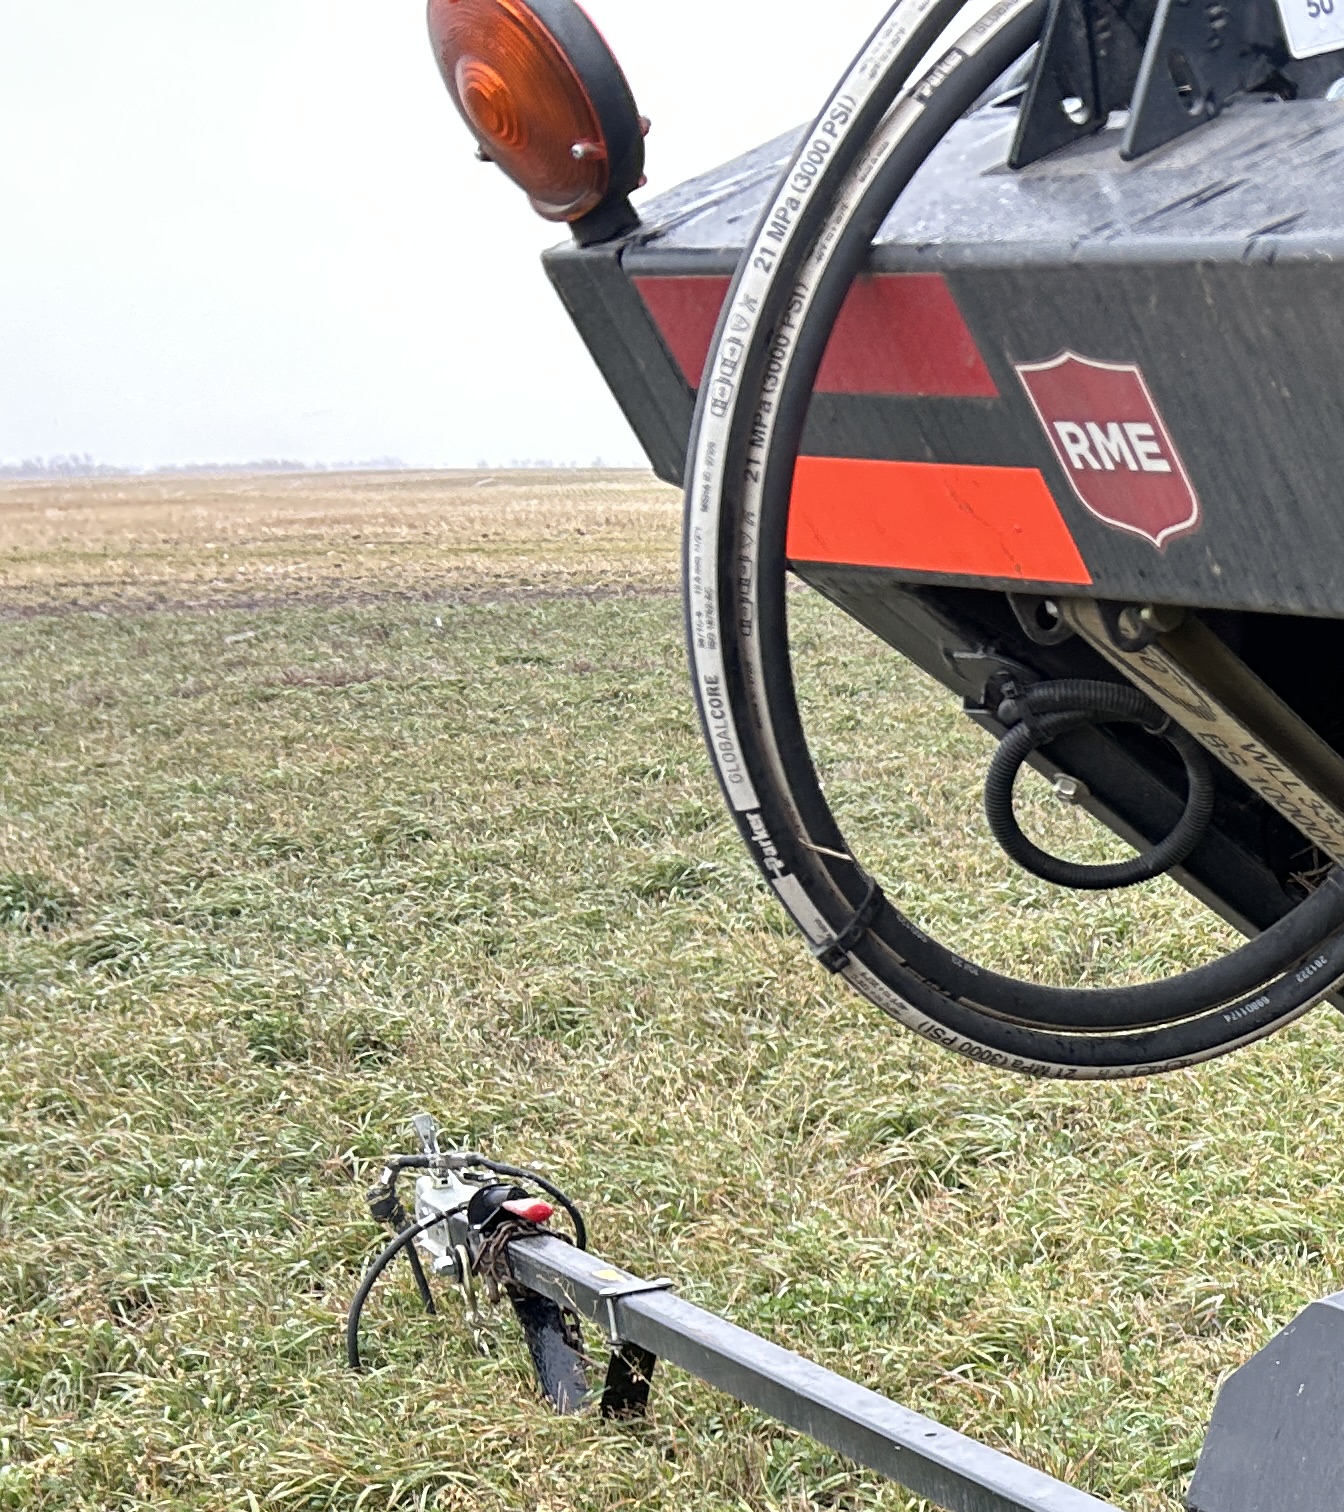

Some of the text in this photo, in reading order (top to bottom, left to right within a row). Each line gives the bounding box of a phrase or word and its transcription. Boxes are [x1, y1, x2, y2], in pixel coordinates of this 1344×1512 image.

[754, 248, 777, 274] 21
[767, 197, 801, 242] MPa
[791, 139, 831, 196] (3000
[822, 95, 857, 139] PSI)
[763, 335, 791, 393] (3000
[751, 403, 773, 449] MPa
[1054, 420, 1173, 474] RME
[744, 458, 760, 483] 21
[703, 674, 784, 879] Parker GLOBALCORE
[1240, 742, 1303, 796] WLL
[914, 1018, 959, 1048] PSI)
[957, 1039, 1009, 1067] (3000
